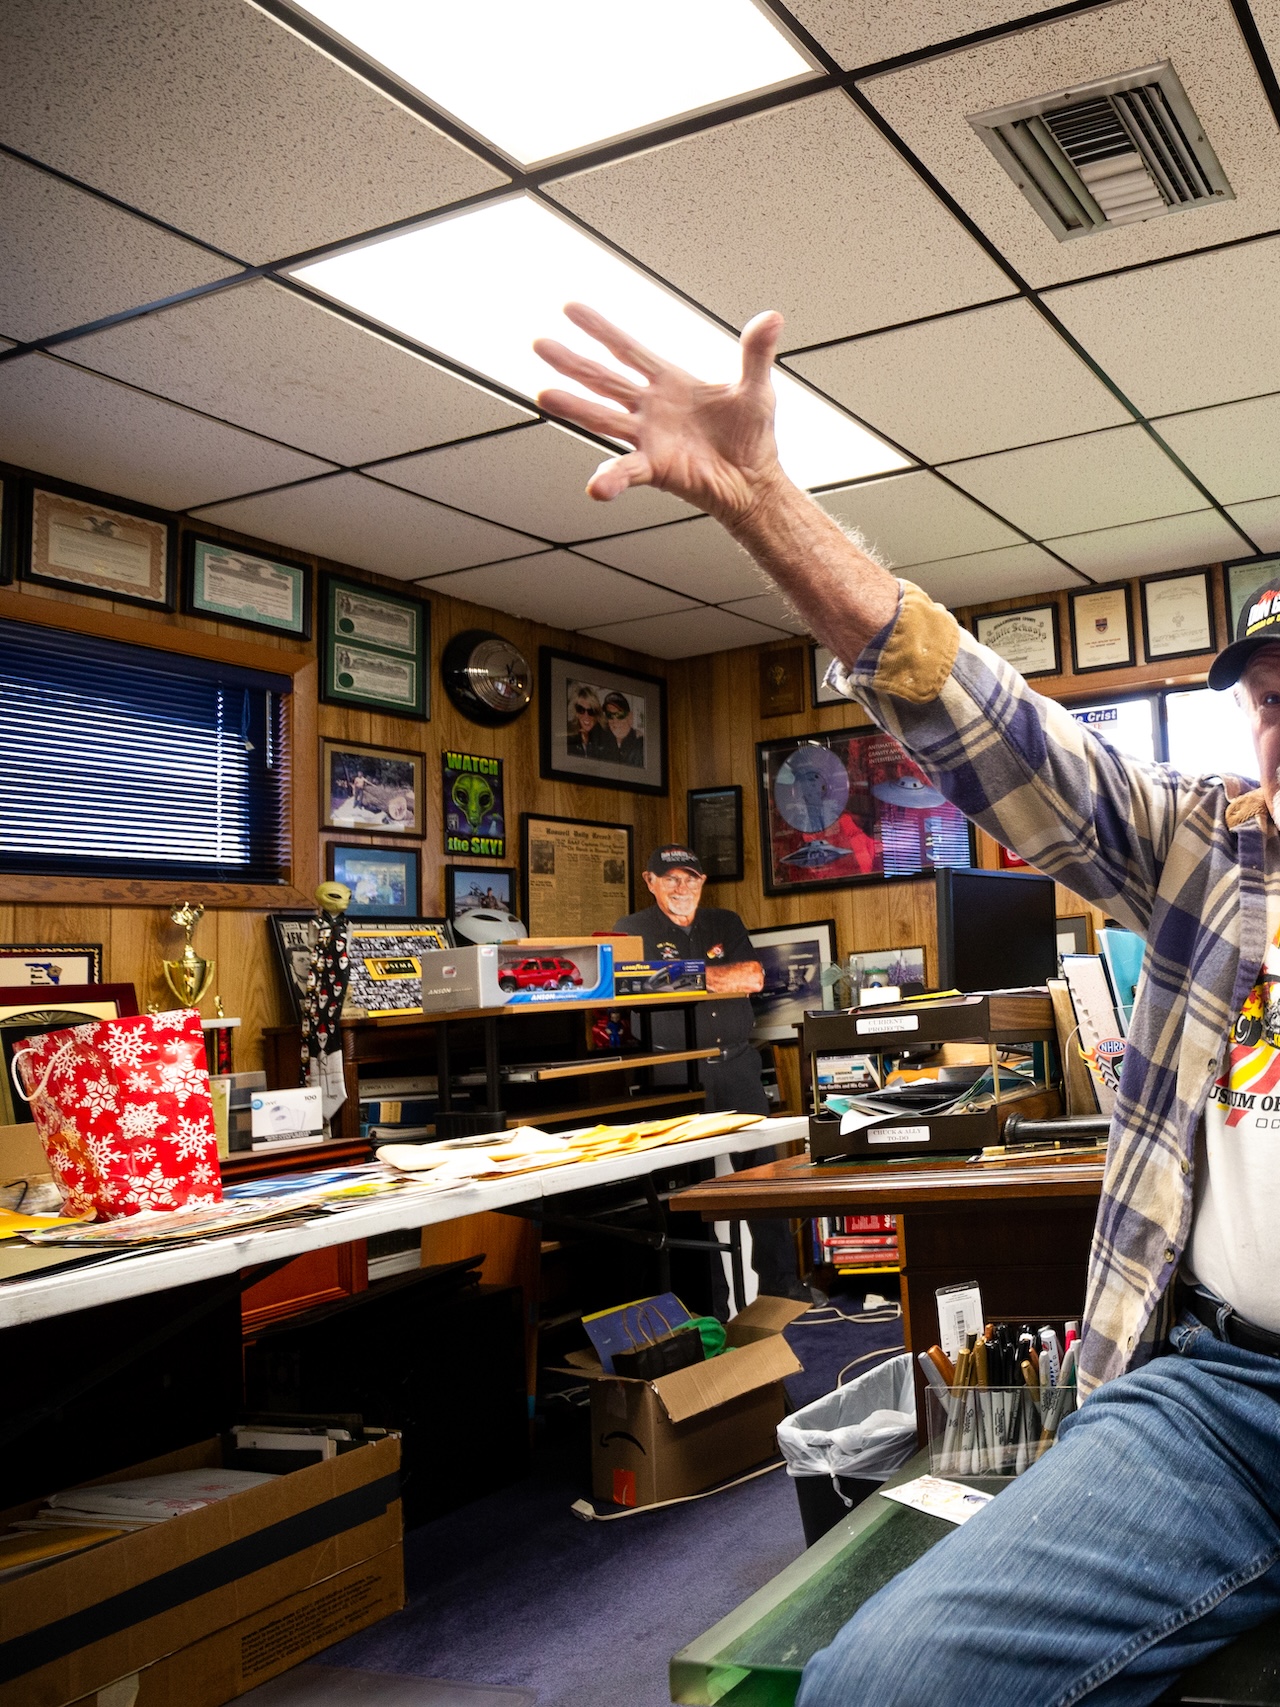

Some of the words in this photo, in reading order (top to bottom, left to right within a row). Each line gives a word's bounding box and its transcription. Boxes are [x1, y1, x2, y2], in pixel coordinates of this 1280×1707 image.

[1087, 709, 1117, 723] Crist
[868, 742, 898, 751] ANTIMATTE
[446, 752, 499, 776] WATCH
[448, 837, 469, 852] the
[471, 837, 503, 856] SKY!
[286, 932, 304, 945] JFK
[428, 987, 452, 995] ANSON
[531, 993, 556, 1001] ANSON
[868, 1018, 903, 1026] CURRENT
[868, 1025, 905, 1033] PROJECTS
[1100, 1041, 1125, 1053] NHRA
[1208, 1086, 1257, 1111] USUM
